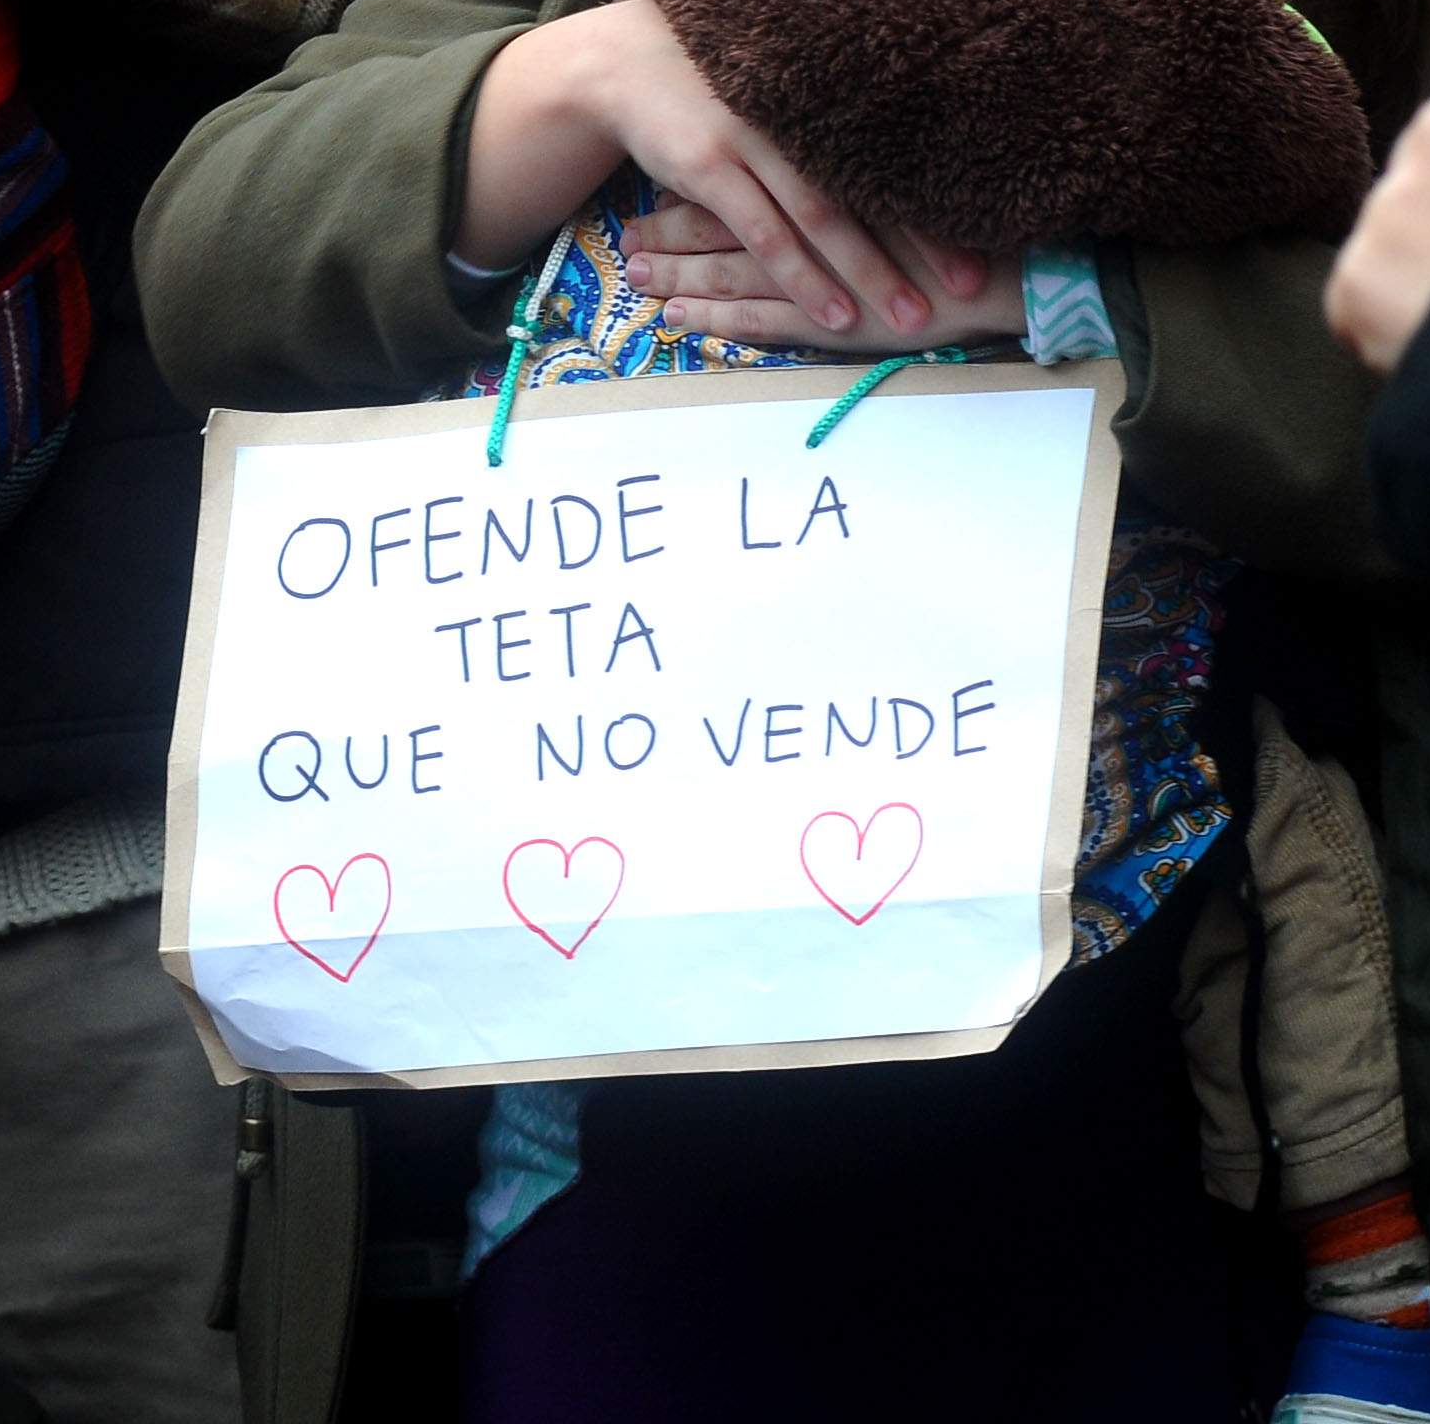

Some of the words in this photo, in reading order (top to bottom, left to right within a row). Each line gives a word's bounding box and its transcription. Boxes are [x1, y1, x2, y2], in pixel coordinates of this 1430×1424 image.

[278, 474, 665, 600] OFENDE
[742, 475, 849, 550] LA
[434, 602, 662, 683] TETA
[258, 725, 444, 803] QUE
[536, 713, 657, 782] NO
[703, 679, 996, 767] VENDE
